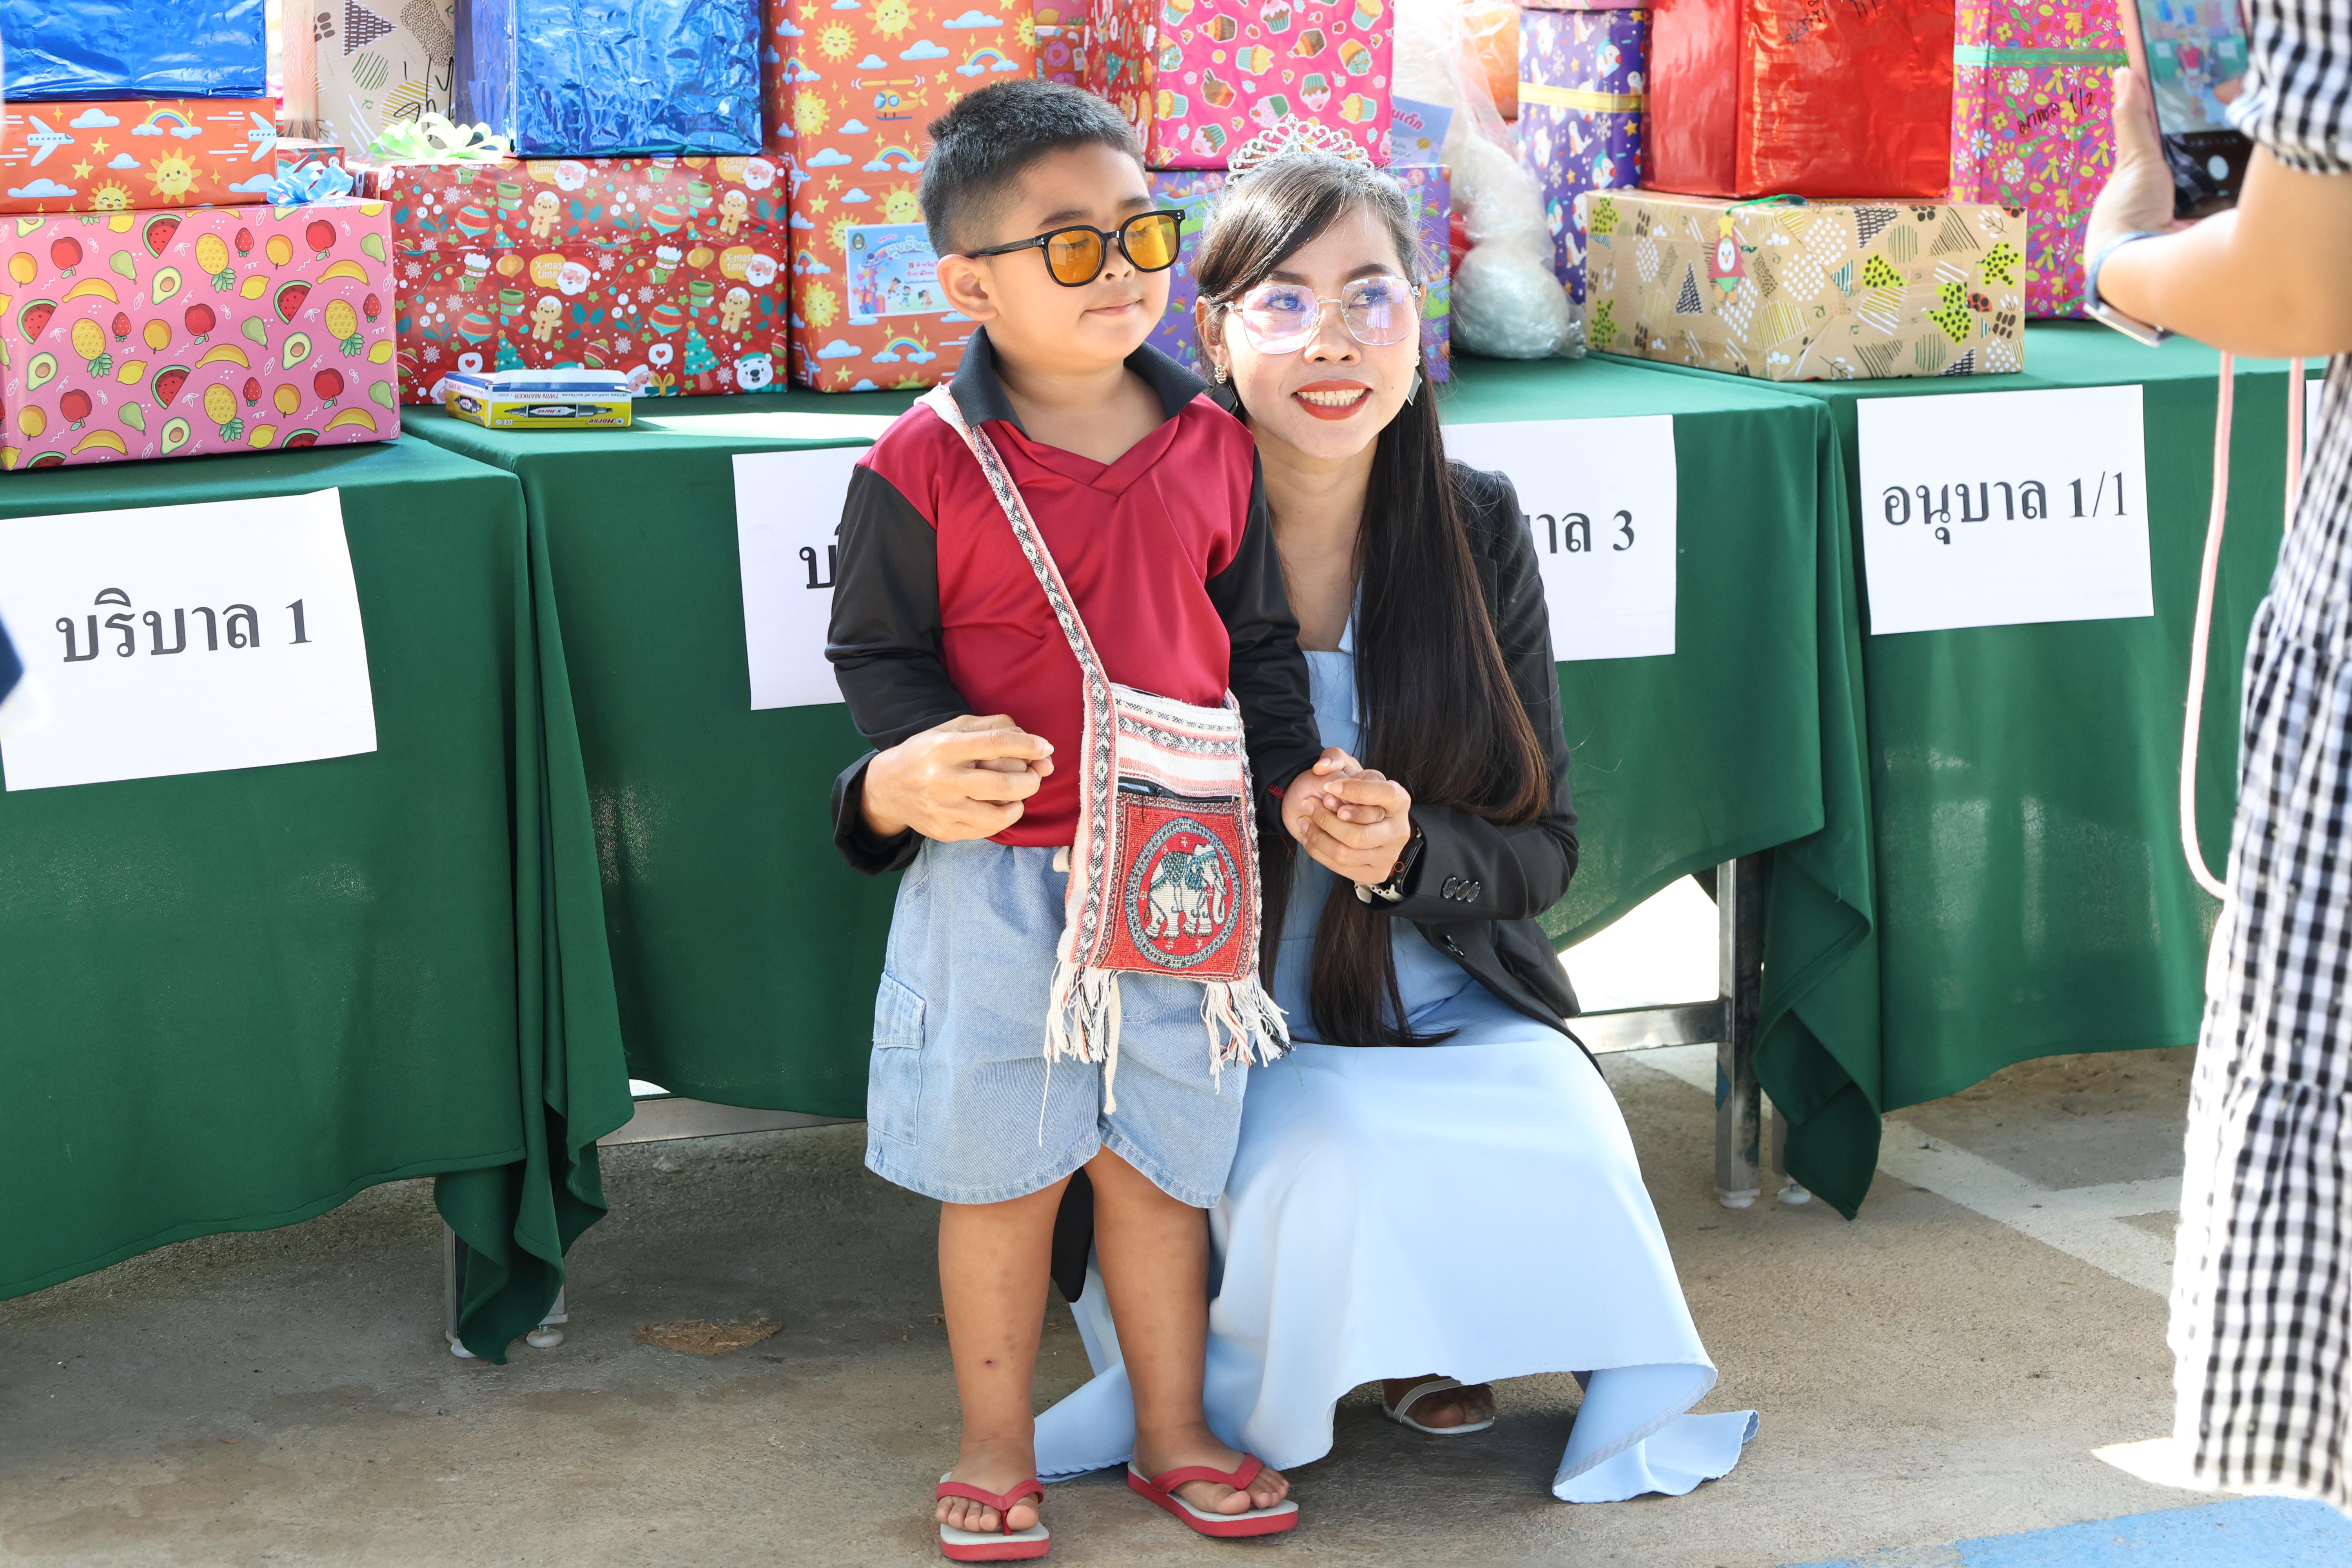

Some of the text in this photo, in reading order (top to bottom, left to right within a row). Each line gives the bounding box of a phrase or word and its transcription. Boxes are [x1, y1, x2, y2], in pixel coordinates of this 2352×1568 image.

[1392, 109, 1424, 130] นเด็ก
[535, 164, 554, 174] time
[724, 164, 743, 173] time
[887, 236, 932, 257] สุขสันต
[724, 253, 751, 262] X-mas
[535, 261, 562, 270] X-mas
[727, 261, 747, 271] time
[537, 270, 558, 279] time
[1882, 471, 2128, 545] อนุบาล 1/1
[1524, 510, 1635, 554] าล 3
[799, 523, 841, 589] บ
[55, 587, 312, 662] บริบาล 1
